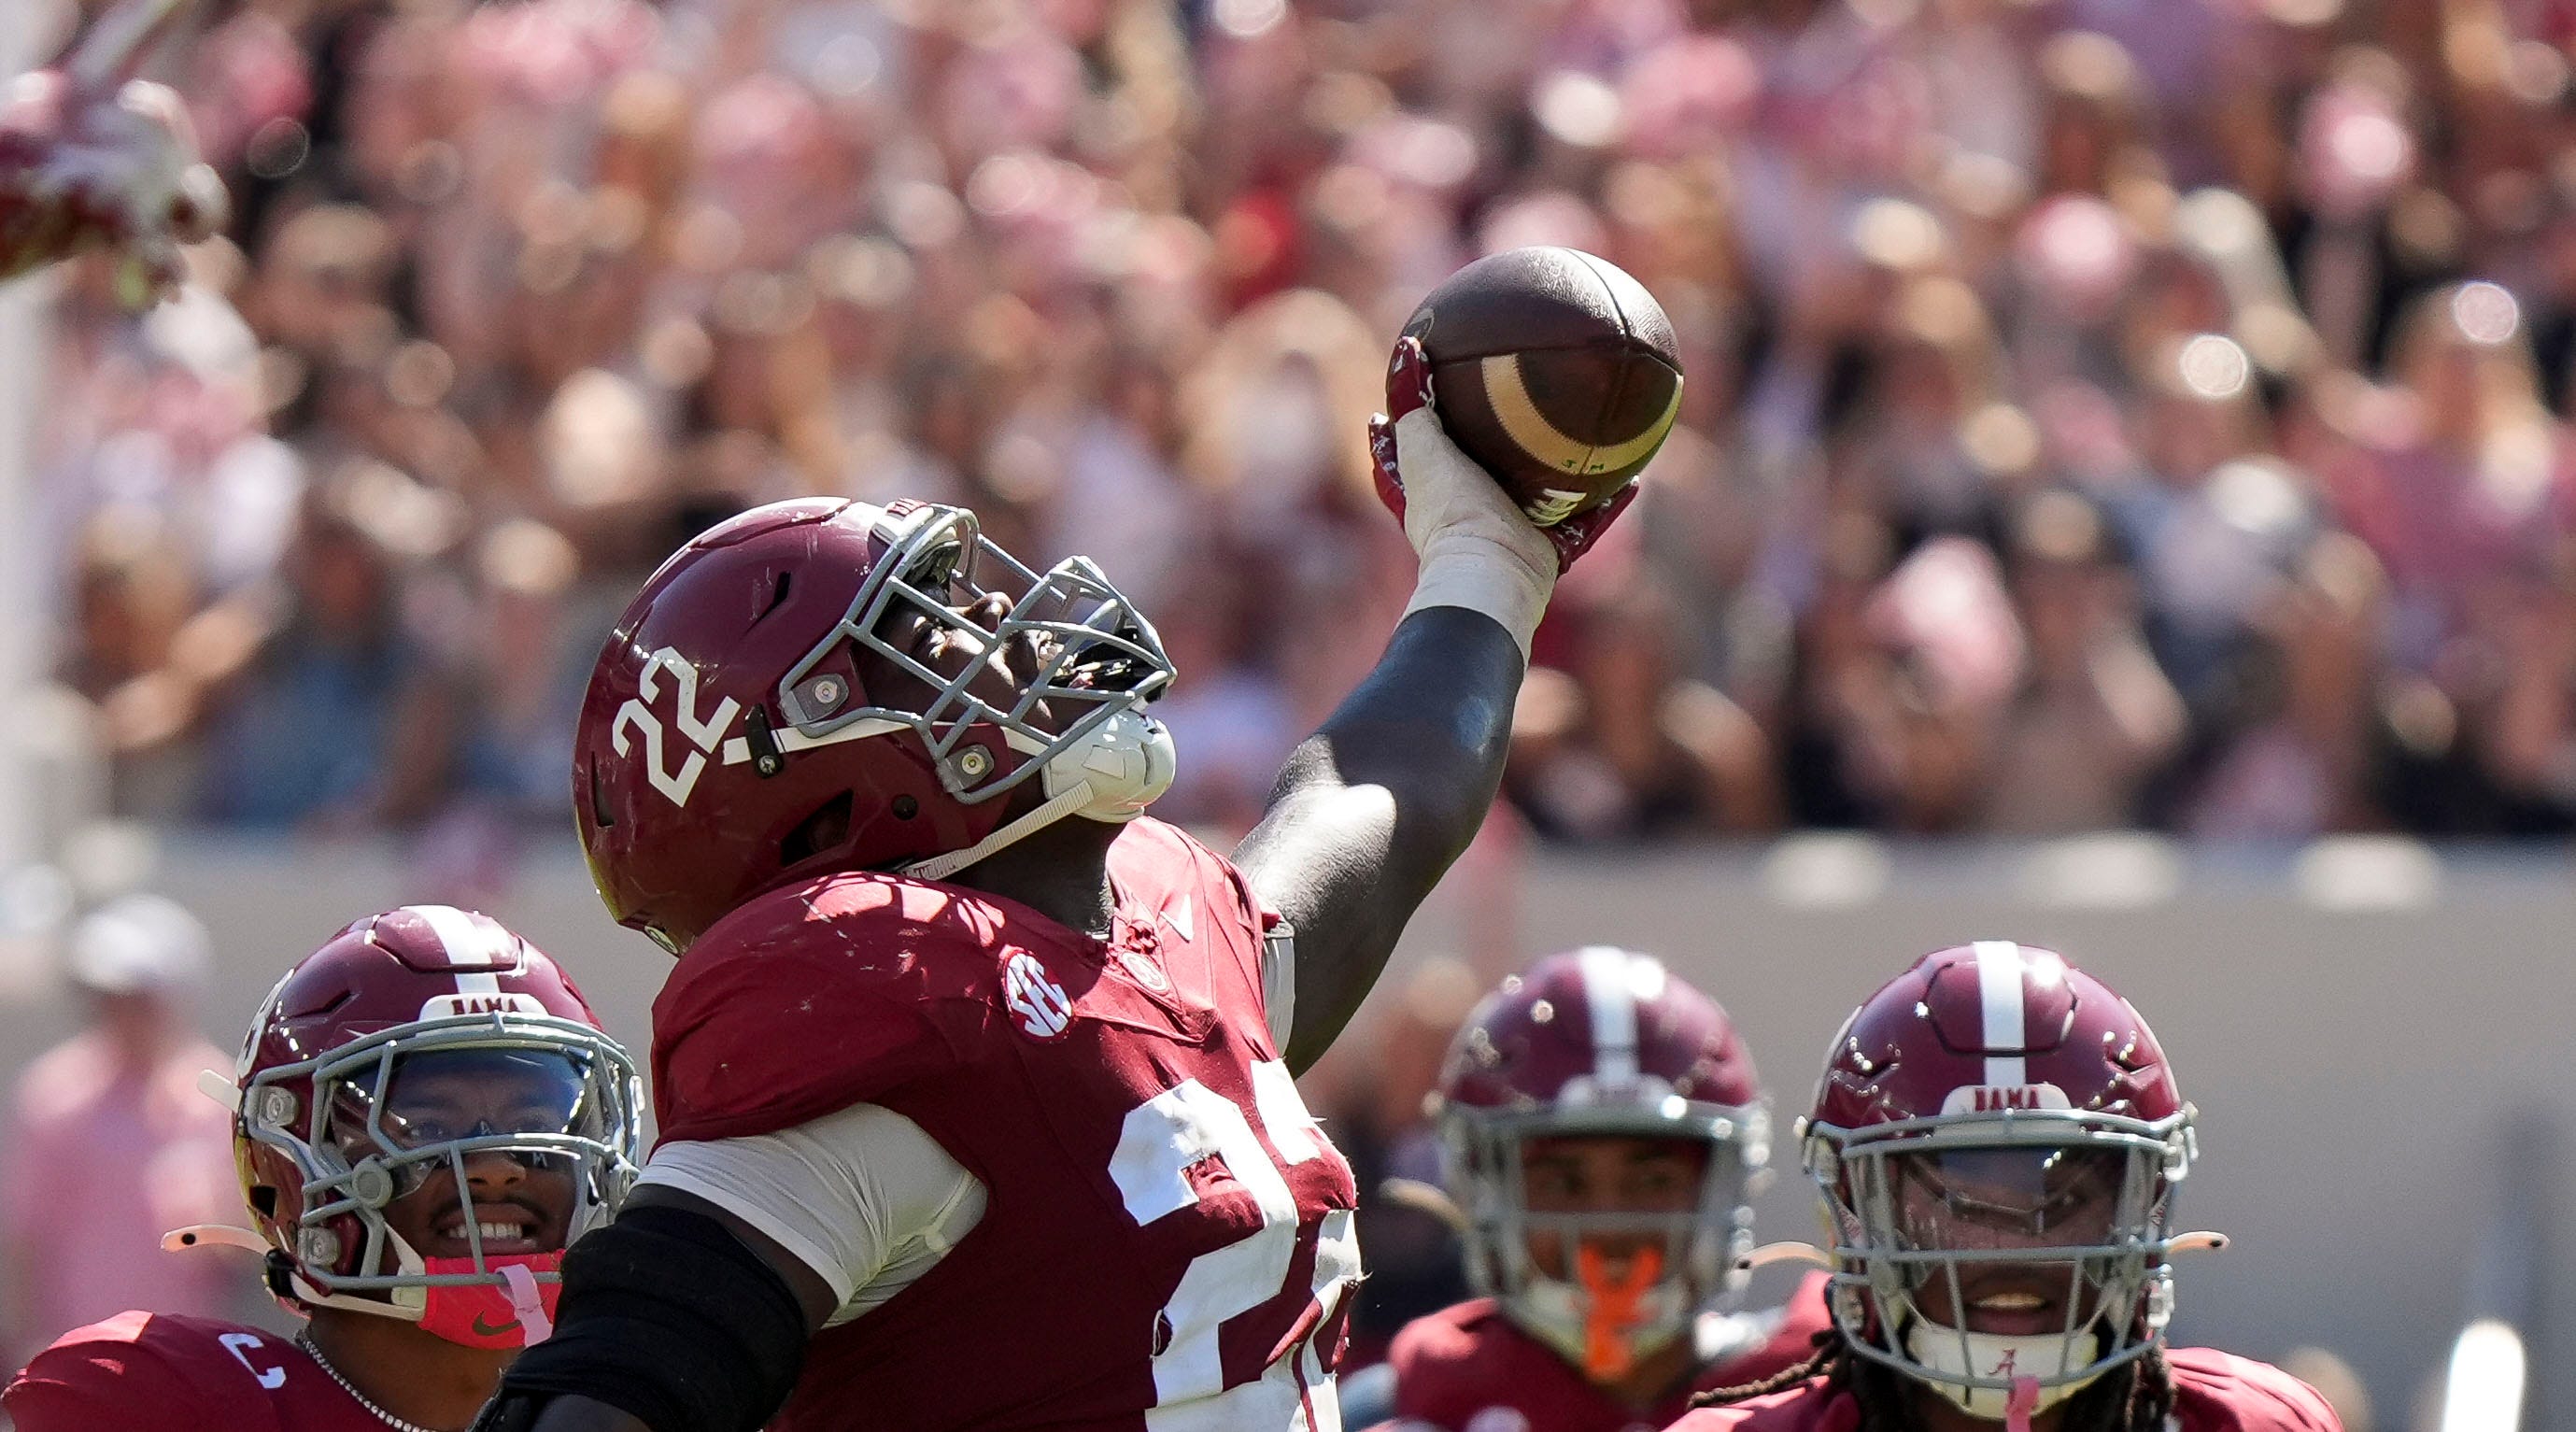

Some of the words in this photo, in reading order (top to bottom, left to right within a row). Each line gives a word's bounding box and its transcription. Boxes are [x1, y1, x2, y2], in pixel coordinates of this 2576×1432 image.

[613, 645, 741, 808] 22
[451, 997, 521, 1016] BAMA
[1006, 953, 1073, 1037] SEC
[1974, 1086, 2041, 1112] BAMA
[218, 1332, 287, 1389] C
